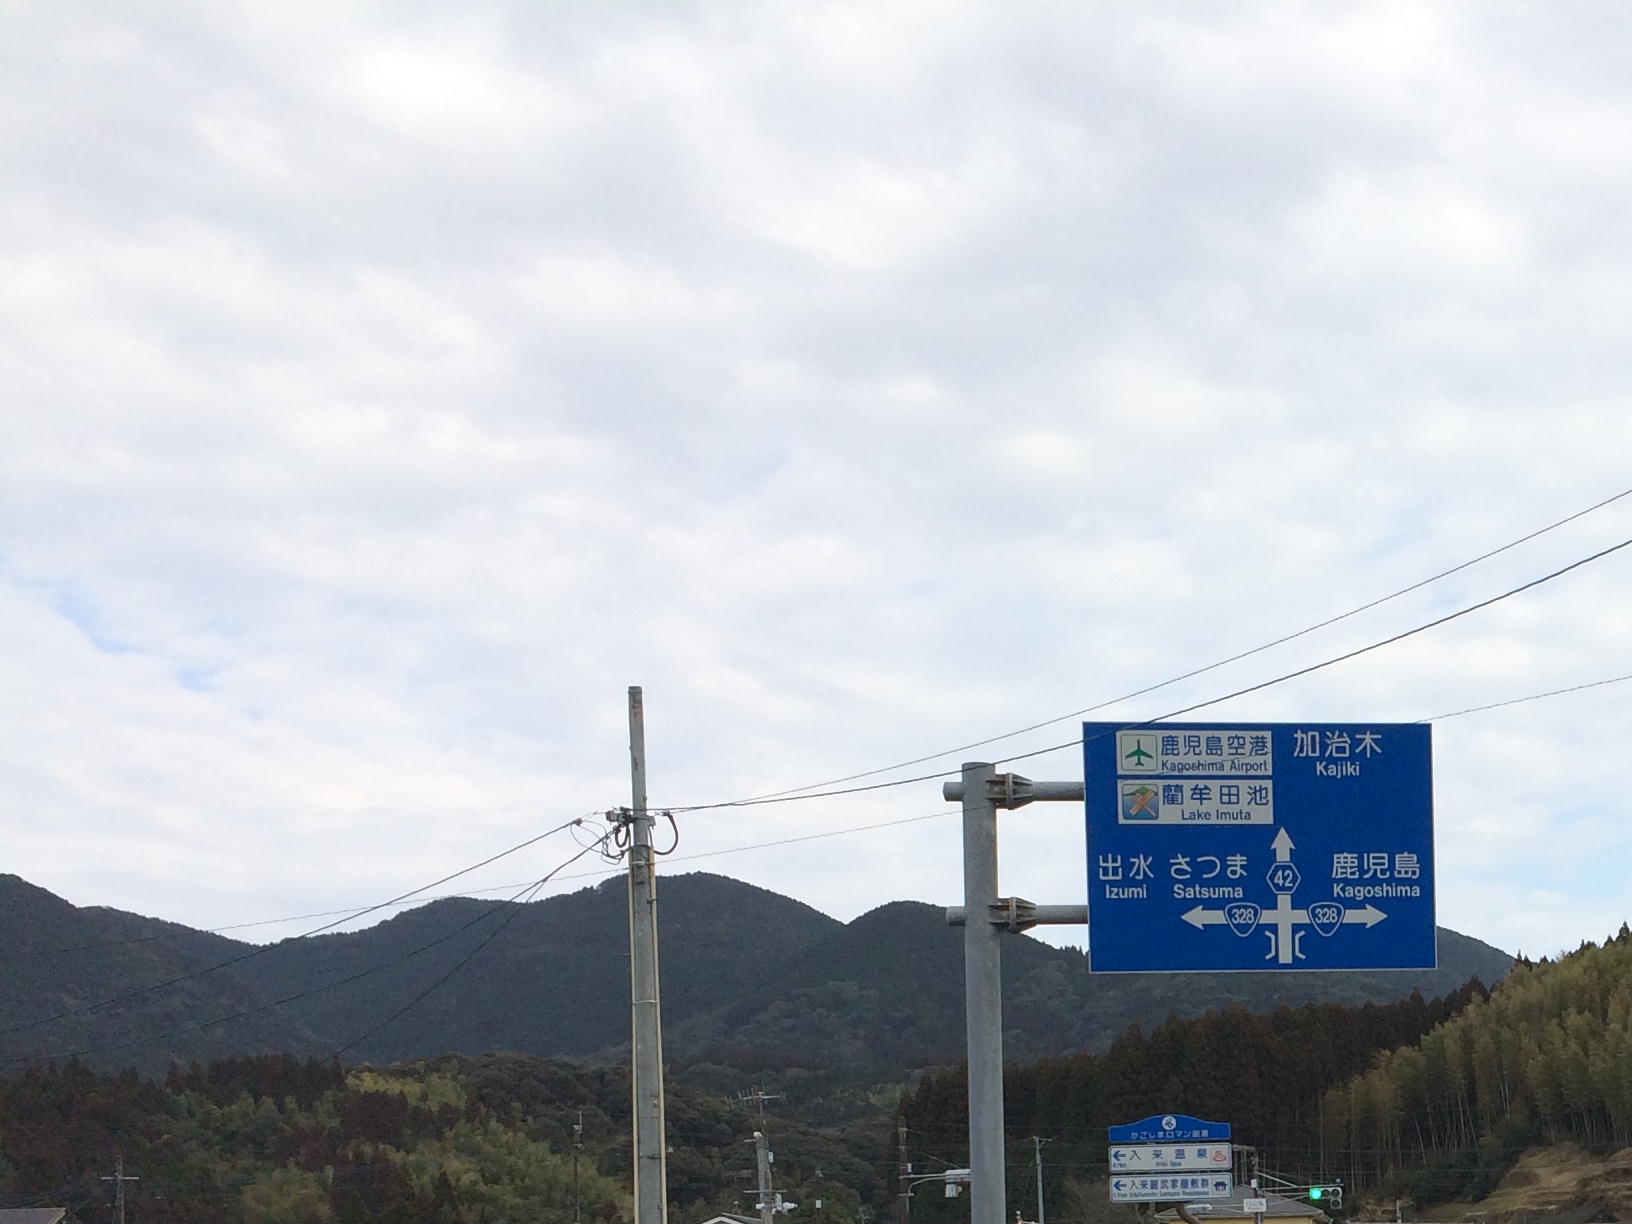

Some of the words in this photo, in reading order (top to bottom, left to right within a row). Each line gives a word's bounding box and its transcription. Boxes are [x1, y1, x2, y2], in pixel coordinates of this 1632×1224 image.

[1161, 734, 1269, 757] 鹿児島空港
[1293, 730, 1382, 758] 加治木
[1161, 759, 1225, 773] Kagoshima
[1229, 759, 1268, 773] Airport
[1316, 761, 1360, 778] Kajiki
[1181, 808, 1212, 821] Lake
[1215, 808, 1251, 821] Imuta
[1098, 854, 1154, 880] 出水
[1169, 854, 1248, 880] さつま
[1331, 853, 1420, 880] 鹿児島
[1273, 870, 1294, 888] 42
[1105, 884, 1147, 899] Izumi
[1173, 884, 1243, 899] Satsuma
[1333, 883, 1421, 900] Kagoshima
[1231, 908, 1255, 924] 328
[1314, 907, 1338, 923] 328
[1129, 1148, 1209, 1161] 入来温泉
